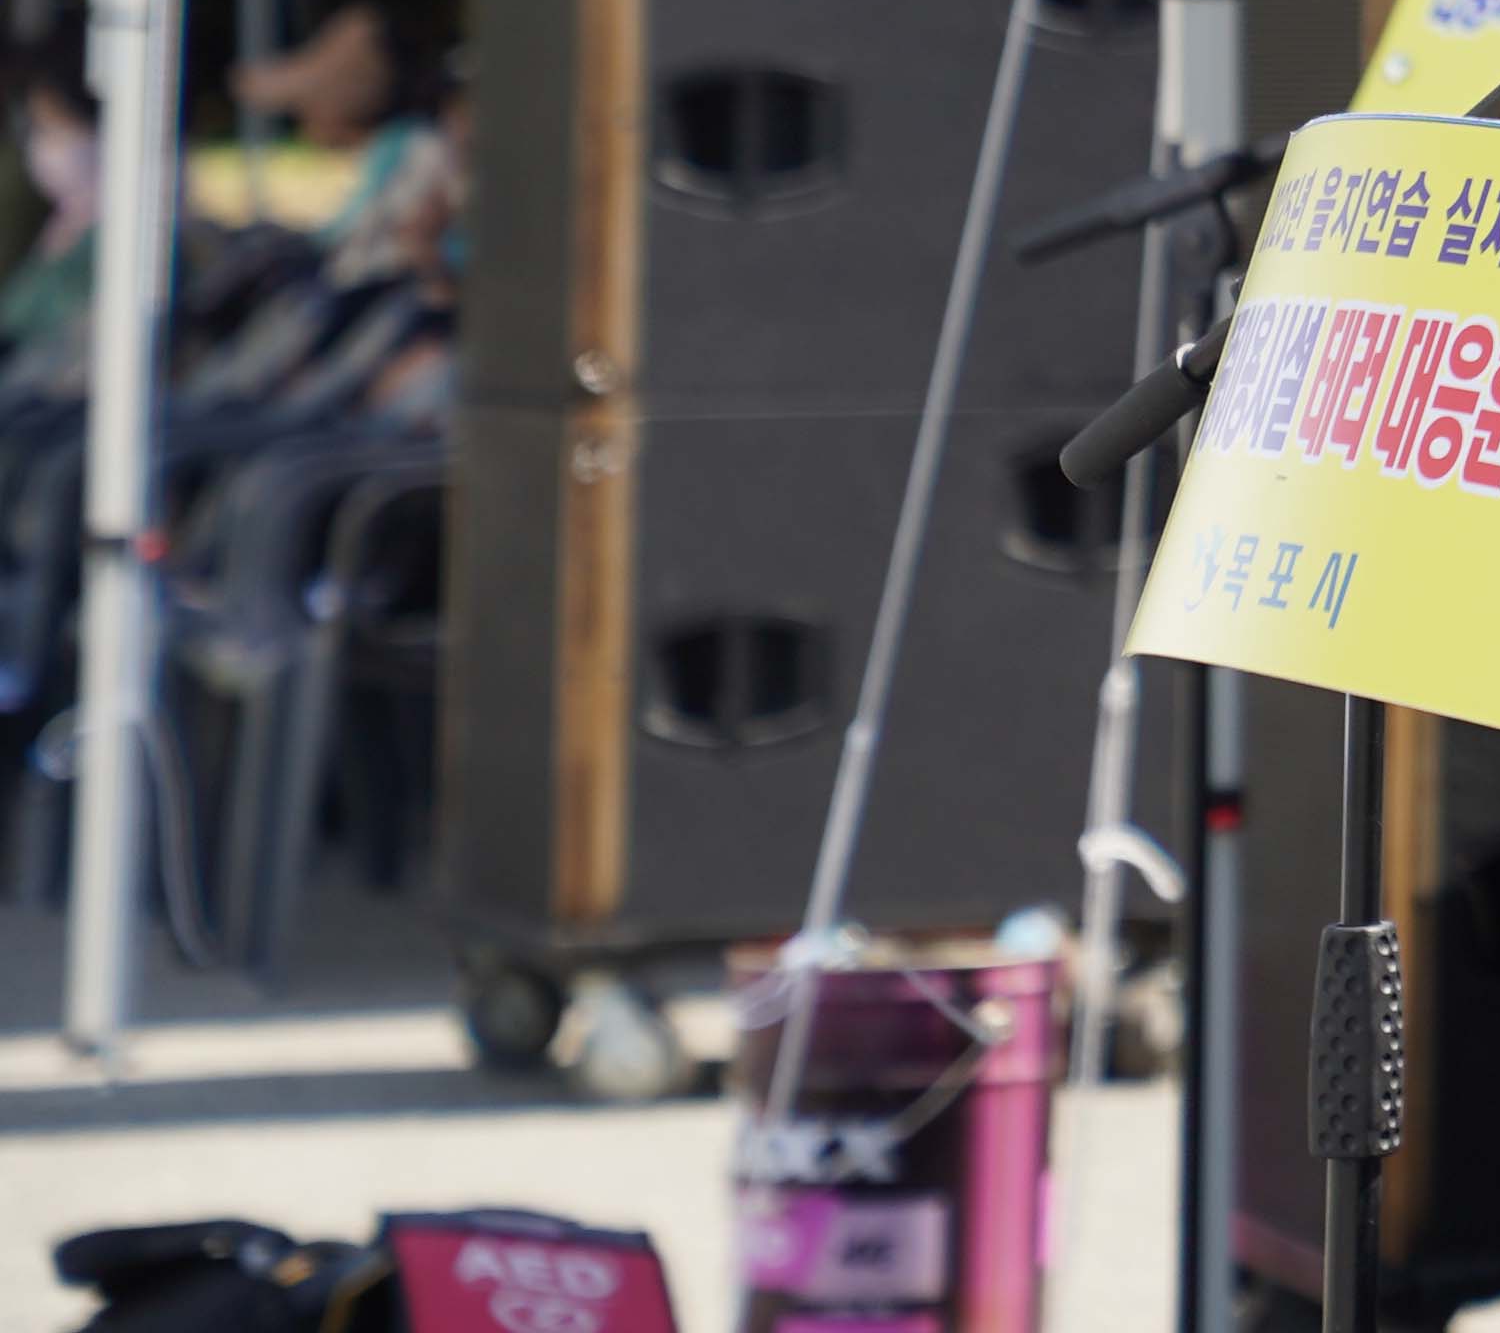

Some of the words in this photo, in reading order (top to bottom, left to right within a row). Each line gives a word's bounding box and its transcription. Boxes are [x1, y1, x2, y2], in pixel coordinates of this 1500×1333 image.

[1303, 165, 1432, 258] 을지연습
[1297, 307, 1401, 463] 테러
[1222, 534, 1360, 630] 목포시
[454, 1238, 620, 1300] AED
